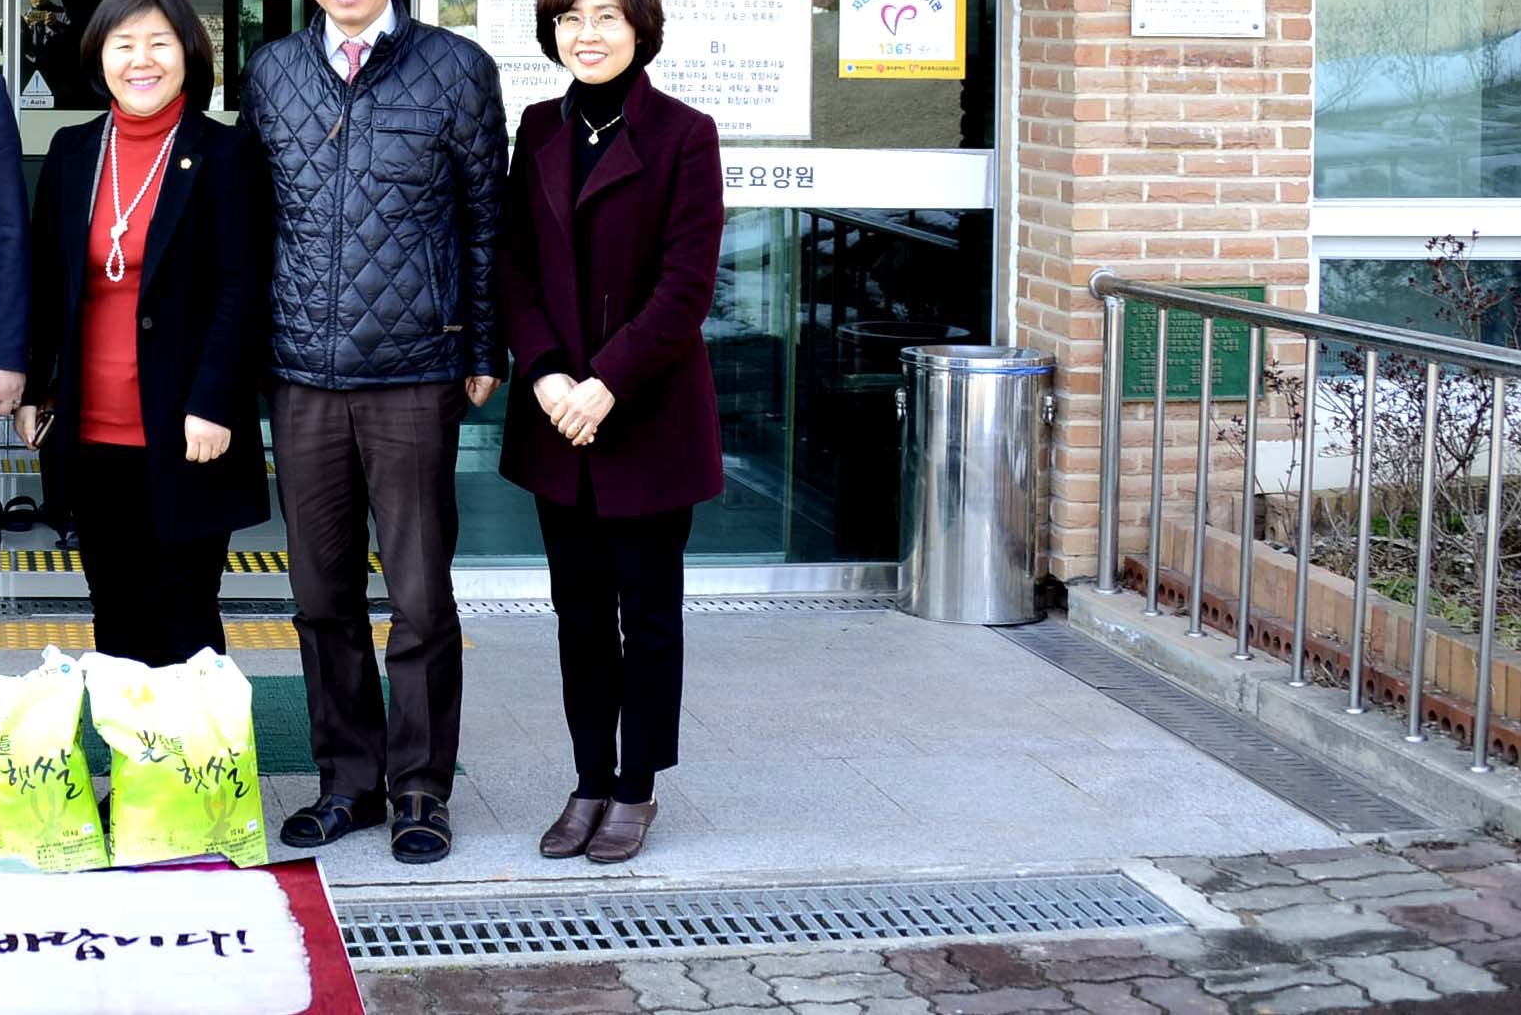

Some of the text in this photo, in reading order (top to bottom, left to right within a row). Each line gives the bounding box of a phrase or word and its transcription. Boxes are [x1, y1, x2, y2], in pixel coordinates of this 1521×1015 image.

[710, 41, 726, 54] B1
[878, 43, 913, 55] 1365
[725, 166, 814, 189] 문요양원
